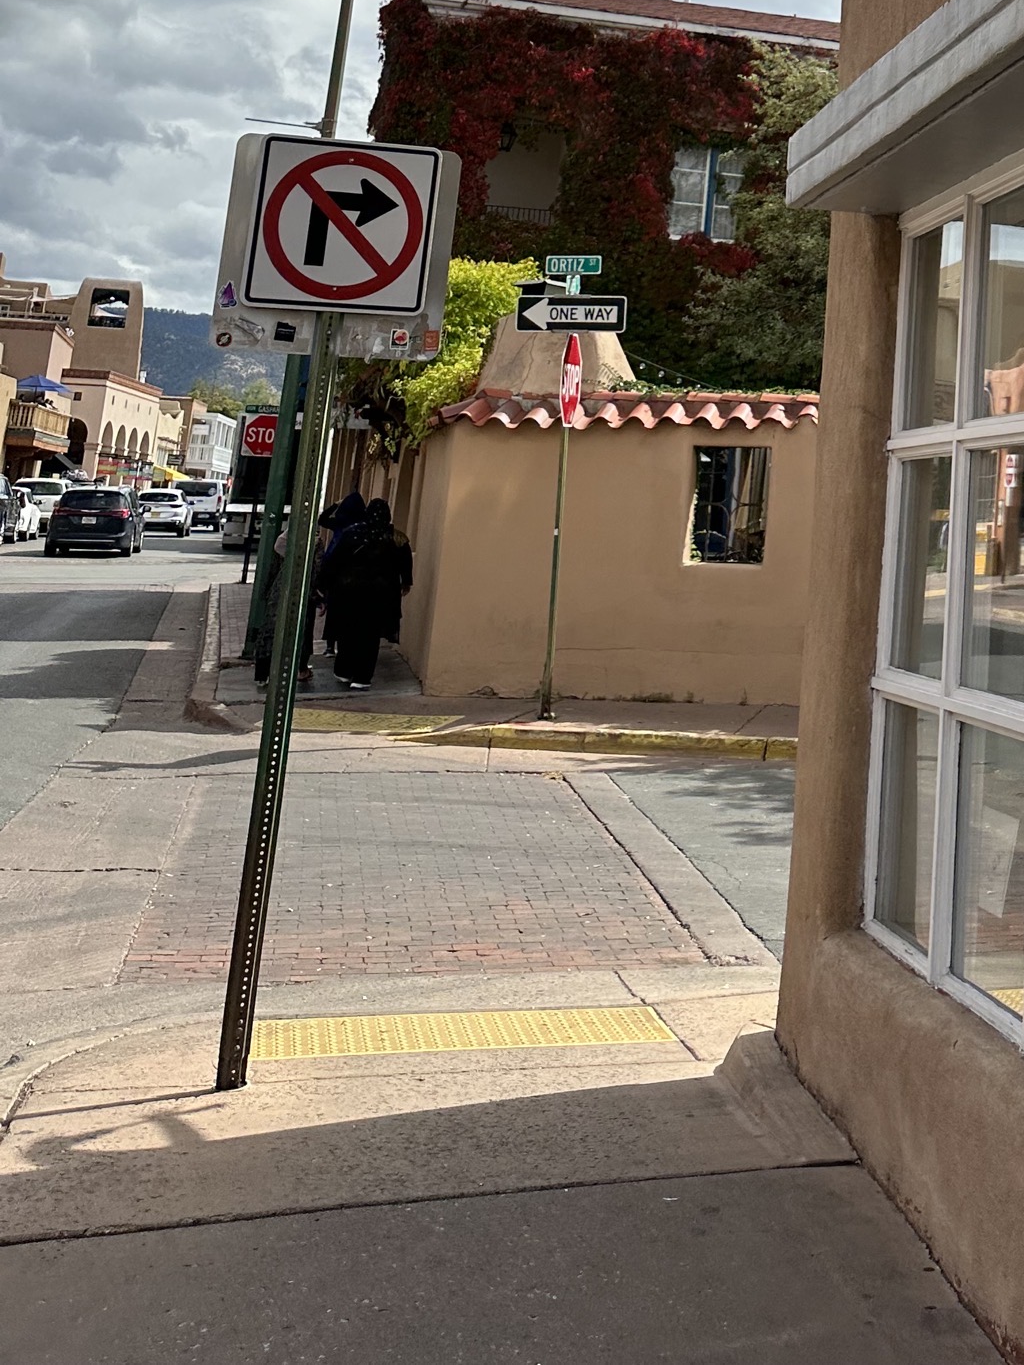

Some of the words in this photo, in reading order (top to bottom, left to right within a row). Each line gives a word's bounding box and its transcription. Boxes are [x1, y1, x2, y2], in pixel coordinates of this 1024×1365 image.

[550, 258, 585, 273] ORTIZ
[589, 258, 598, 267] ST
[549, 307, 579, 321] ONE
[584, 307, 614, 321] WAY
[562, 363, 580, 403] STOP
[247, 427, 275, 443] STO
